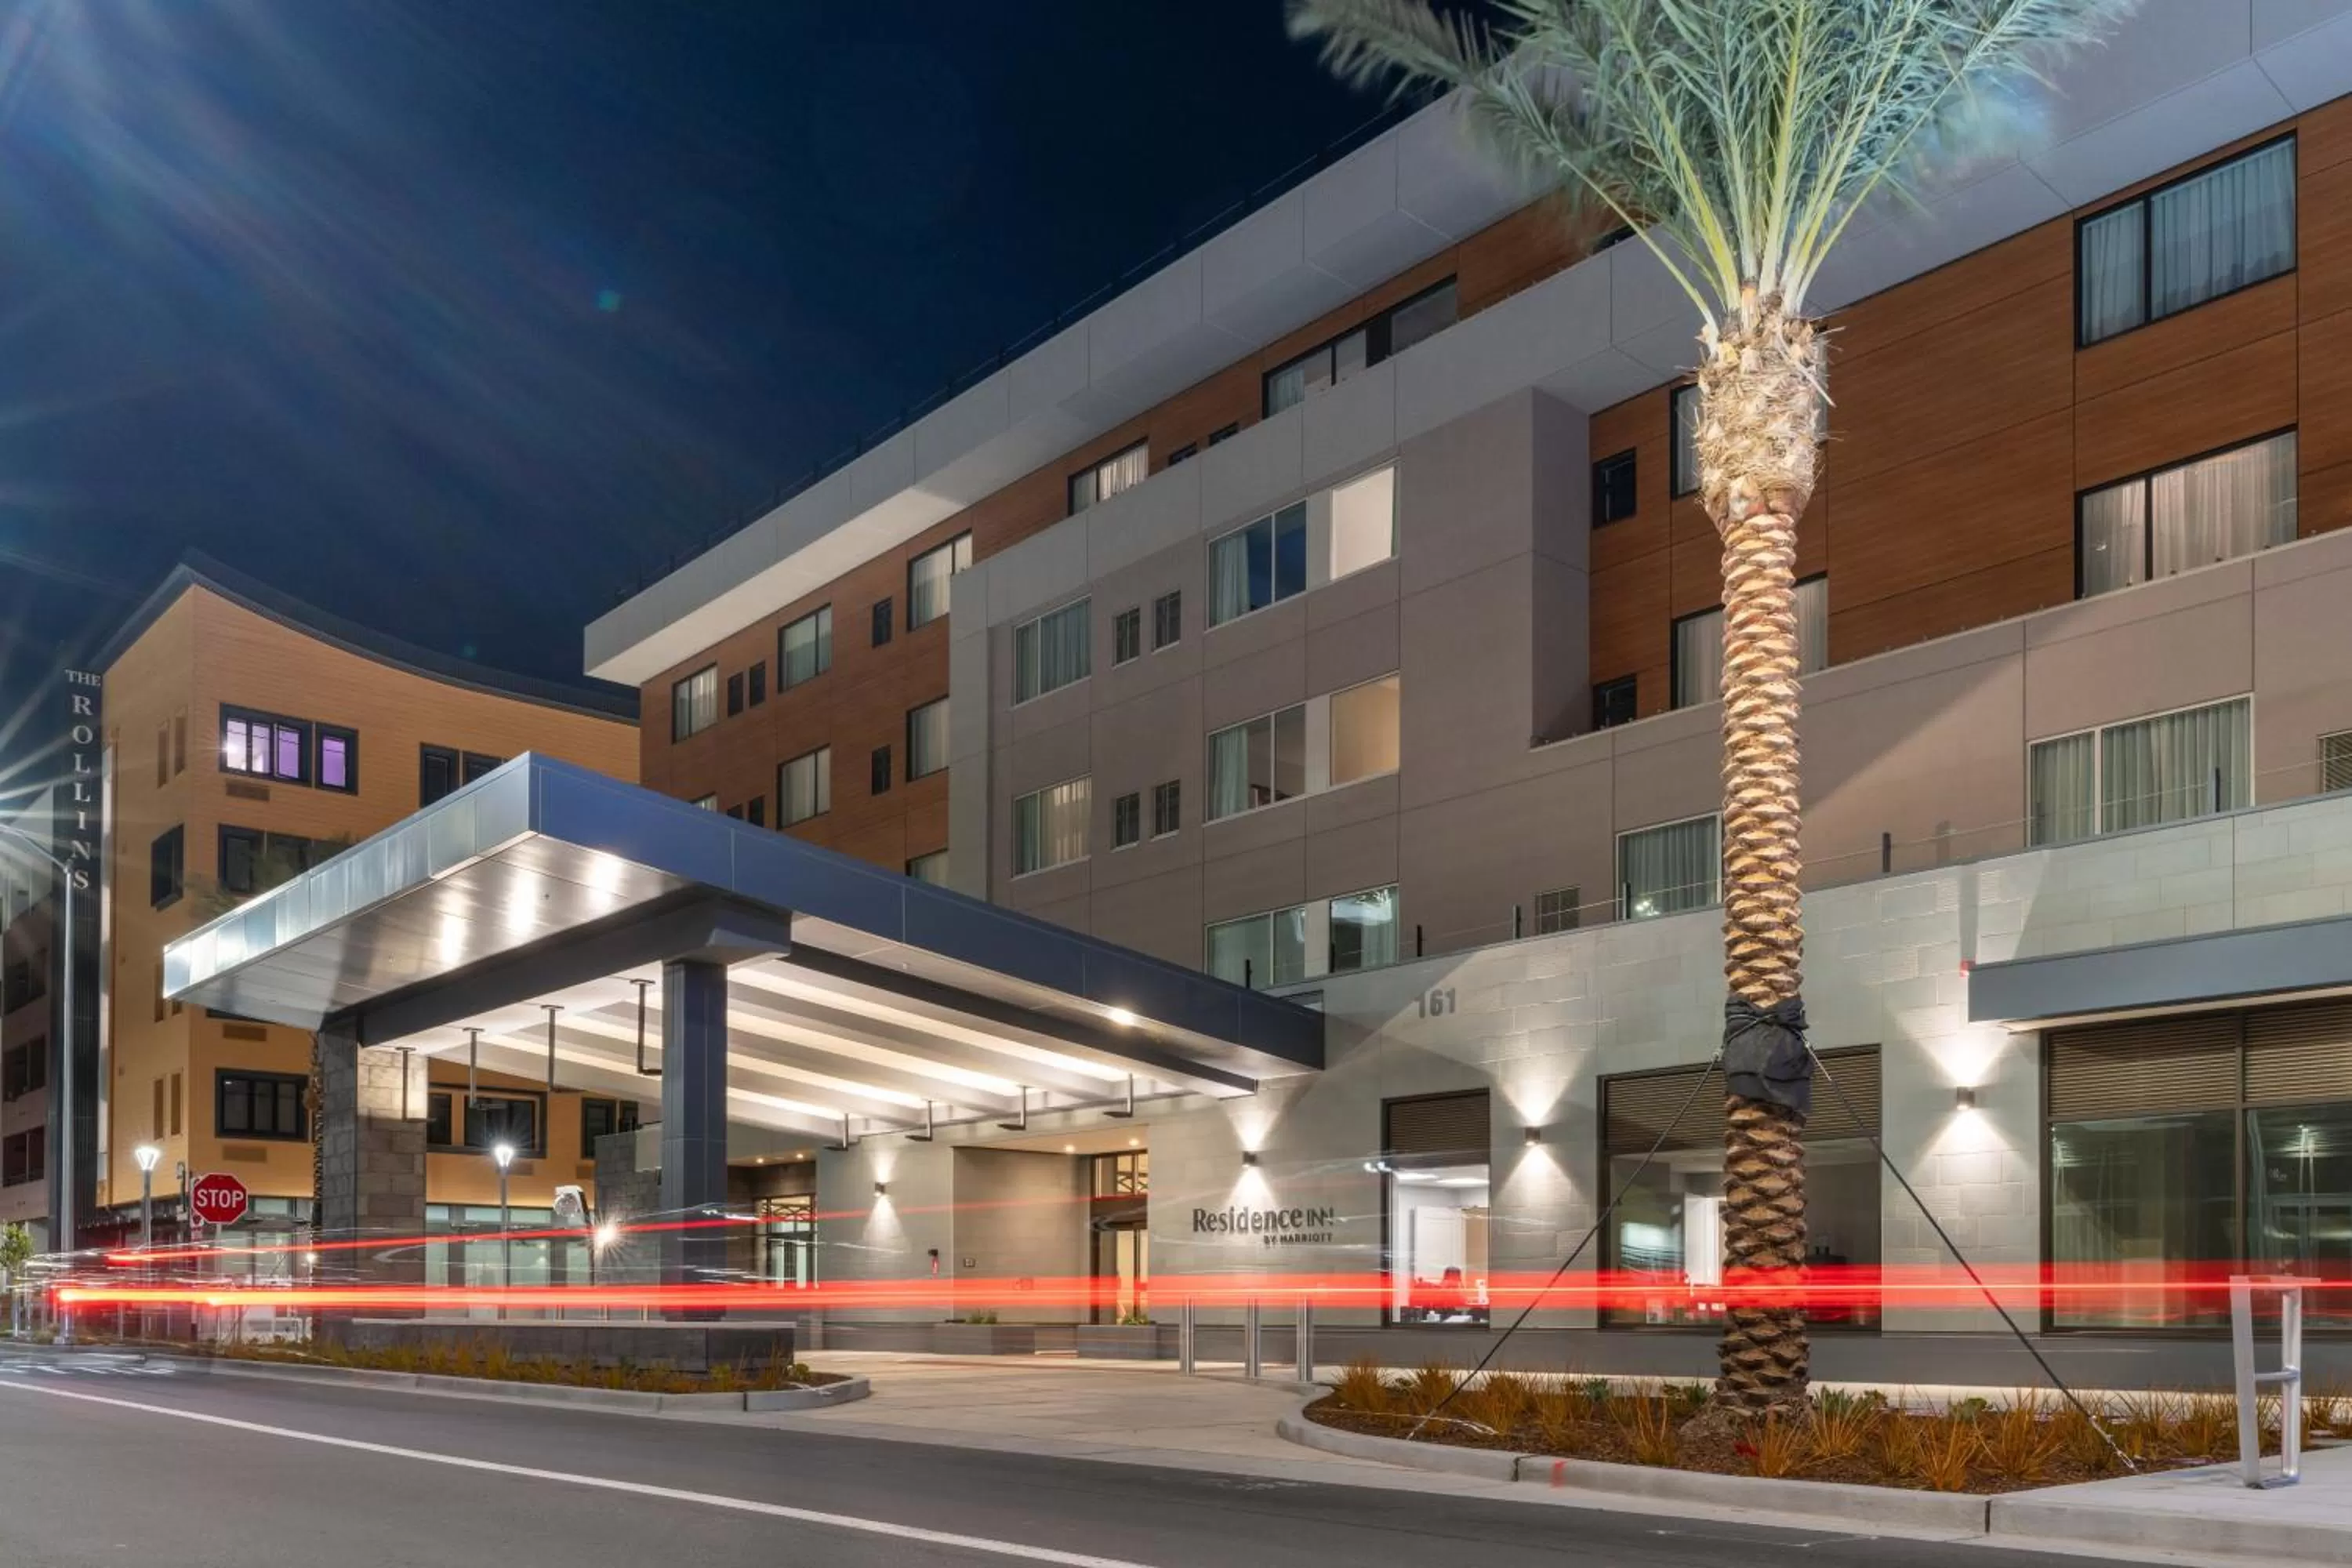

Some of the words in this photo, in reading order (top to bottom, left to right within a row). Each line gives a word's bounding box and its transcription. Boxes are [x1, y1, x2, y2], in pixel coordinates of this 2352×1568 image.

[64, 669, 101, 687] THE
[71, 694, 93, 889] ROLLINS
[1411, 988, 1456, 1019] 161
[196, 1189, 245, 1208] STOP
[1192, 1206, 1304, 1234] Residence
[1263, 1235, 1277, 1245] BY
[1279, 1232, 1334, 1243] MARRIOTT
